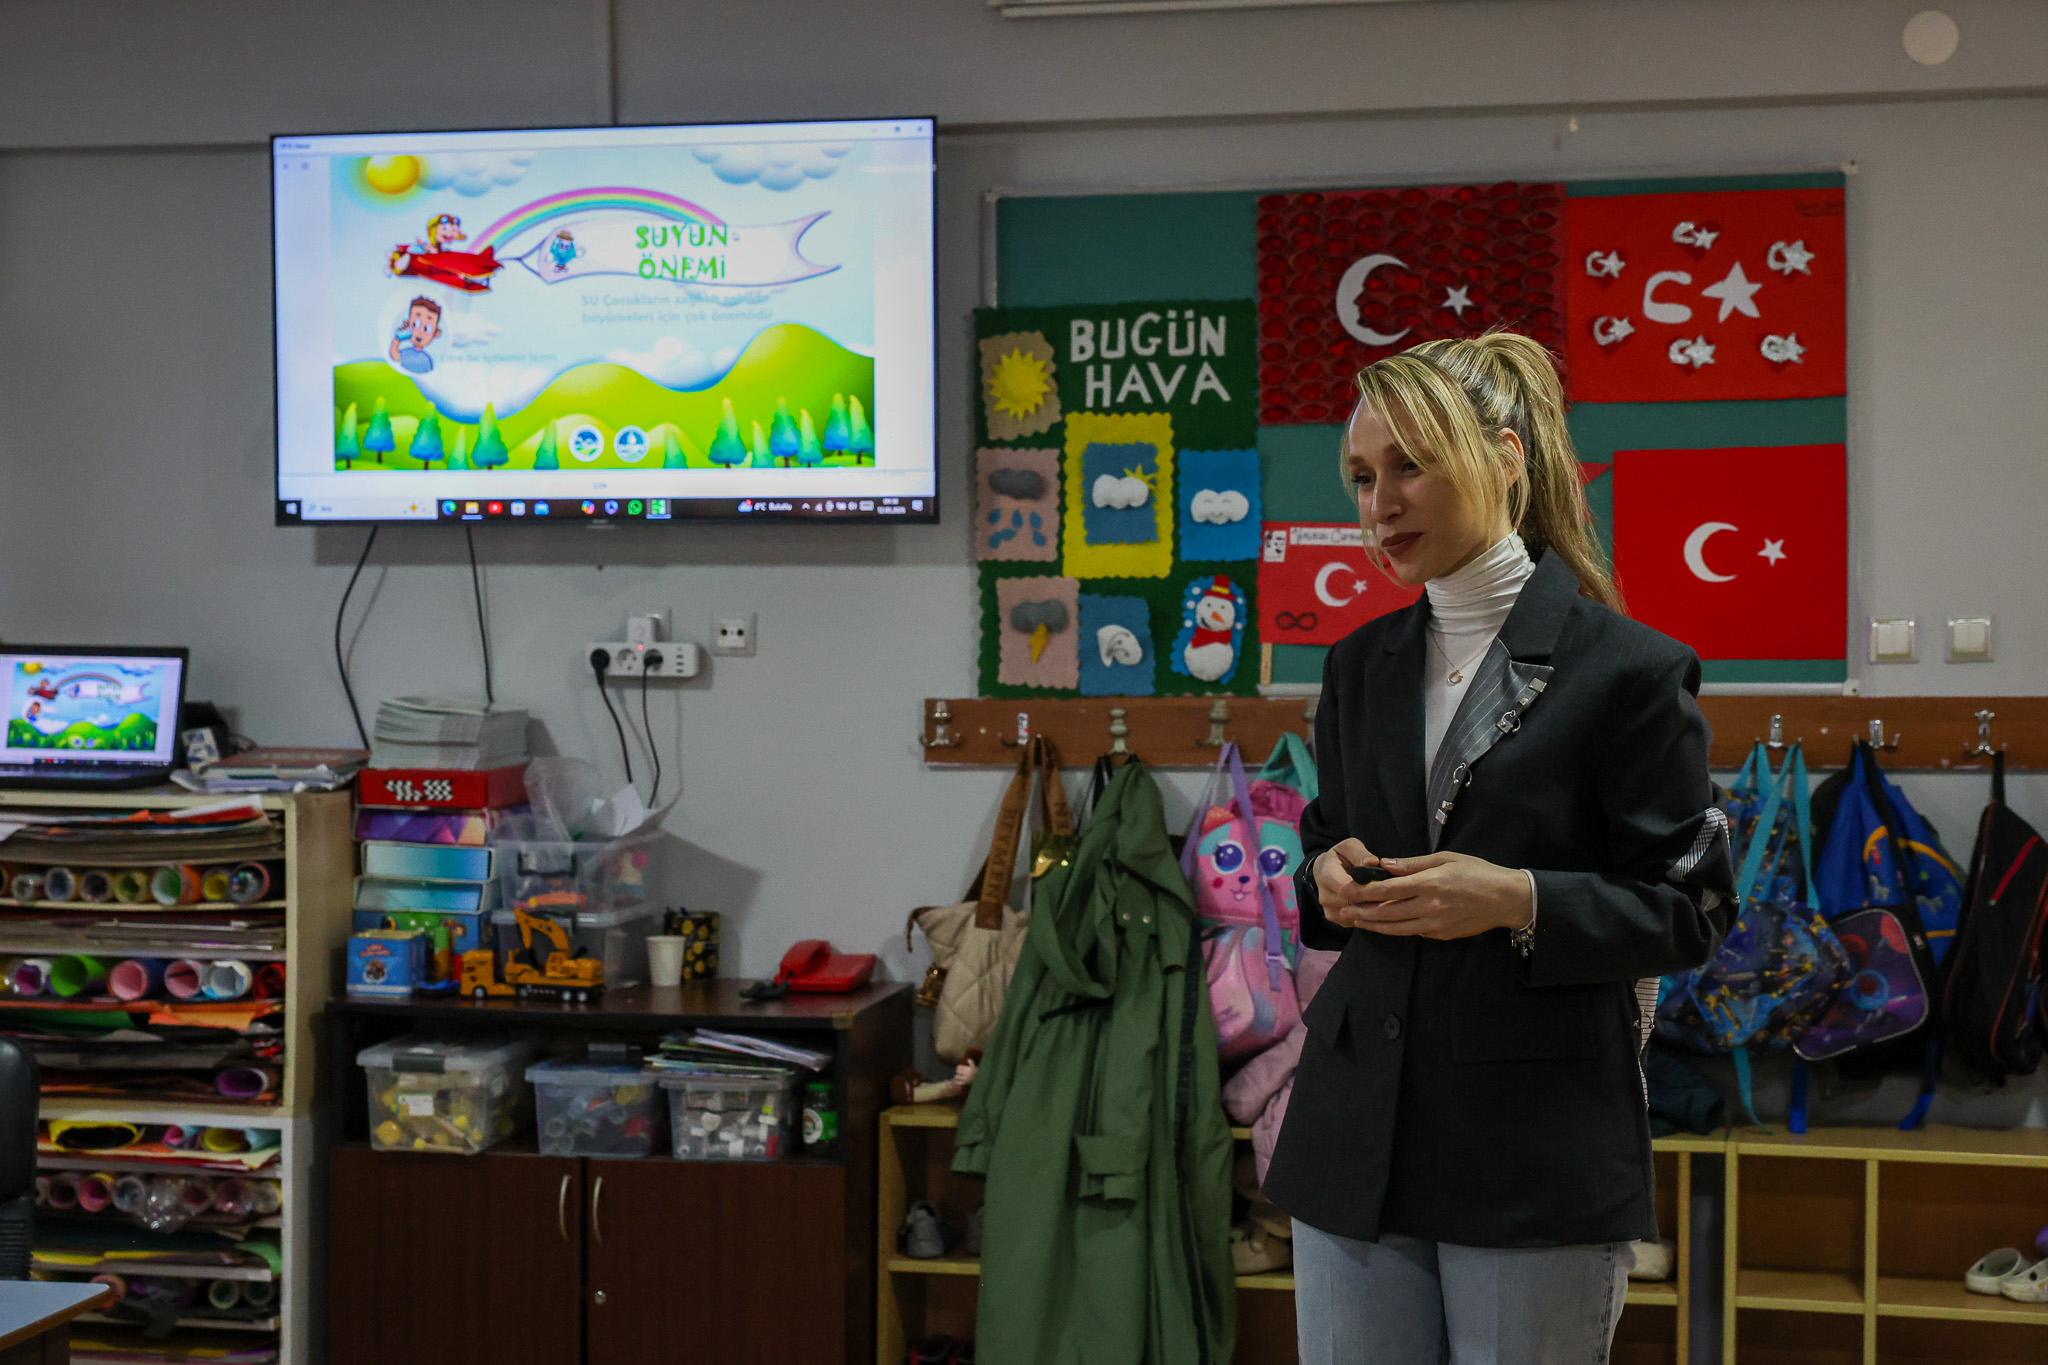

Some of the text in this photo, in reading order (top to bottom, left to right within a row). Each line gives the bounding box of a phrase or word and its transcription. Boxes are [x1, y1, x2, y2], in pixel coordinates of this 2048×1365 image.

[636, 223, 727, 248] SUYUN
[1071, 309, 1226, 362] BUGÜN
[1085, 361, 1231, 408] HAVA
[987, 808, 1018, 900] BEYMEN
